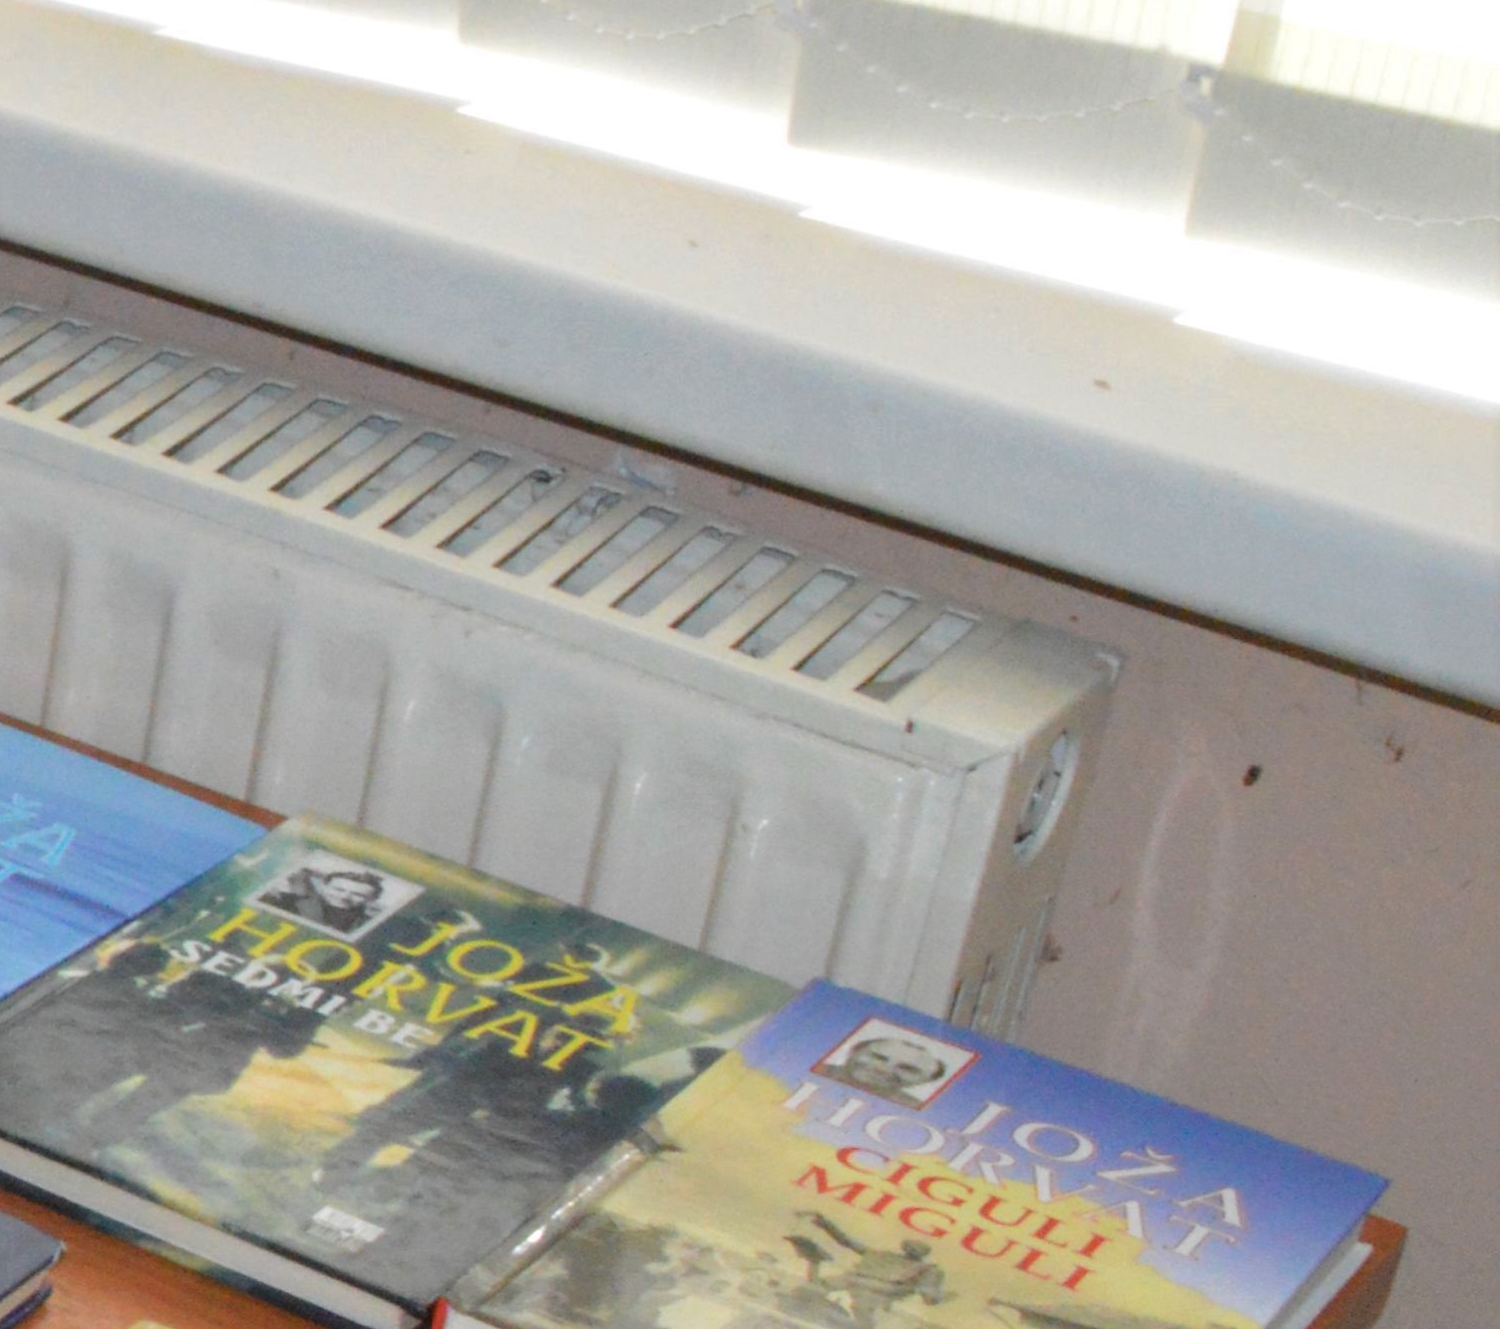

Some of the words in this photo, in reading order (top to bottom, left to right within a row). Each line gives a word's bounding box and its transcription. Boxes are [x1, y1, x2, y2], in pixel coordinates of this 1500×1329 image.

[169, 938, 350, 1017] SEDMI
[356, 1008, 444, 1050] BE
[206, 907, 621, 1071] HORVAT
[389, 913, 645, 1038] JOŽA
[779, 1080, 1241, 1262] HORVAT
[788, 1164, 1095, 1293] MIGULI
[834, 1144, 1114, 1261] CIGULI
[950, 1101, 1246, 1231] JOŽA
